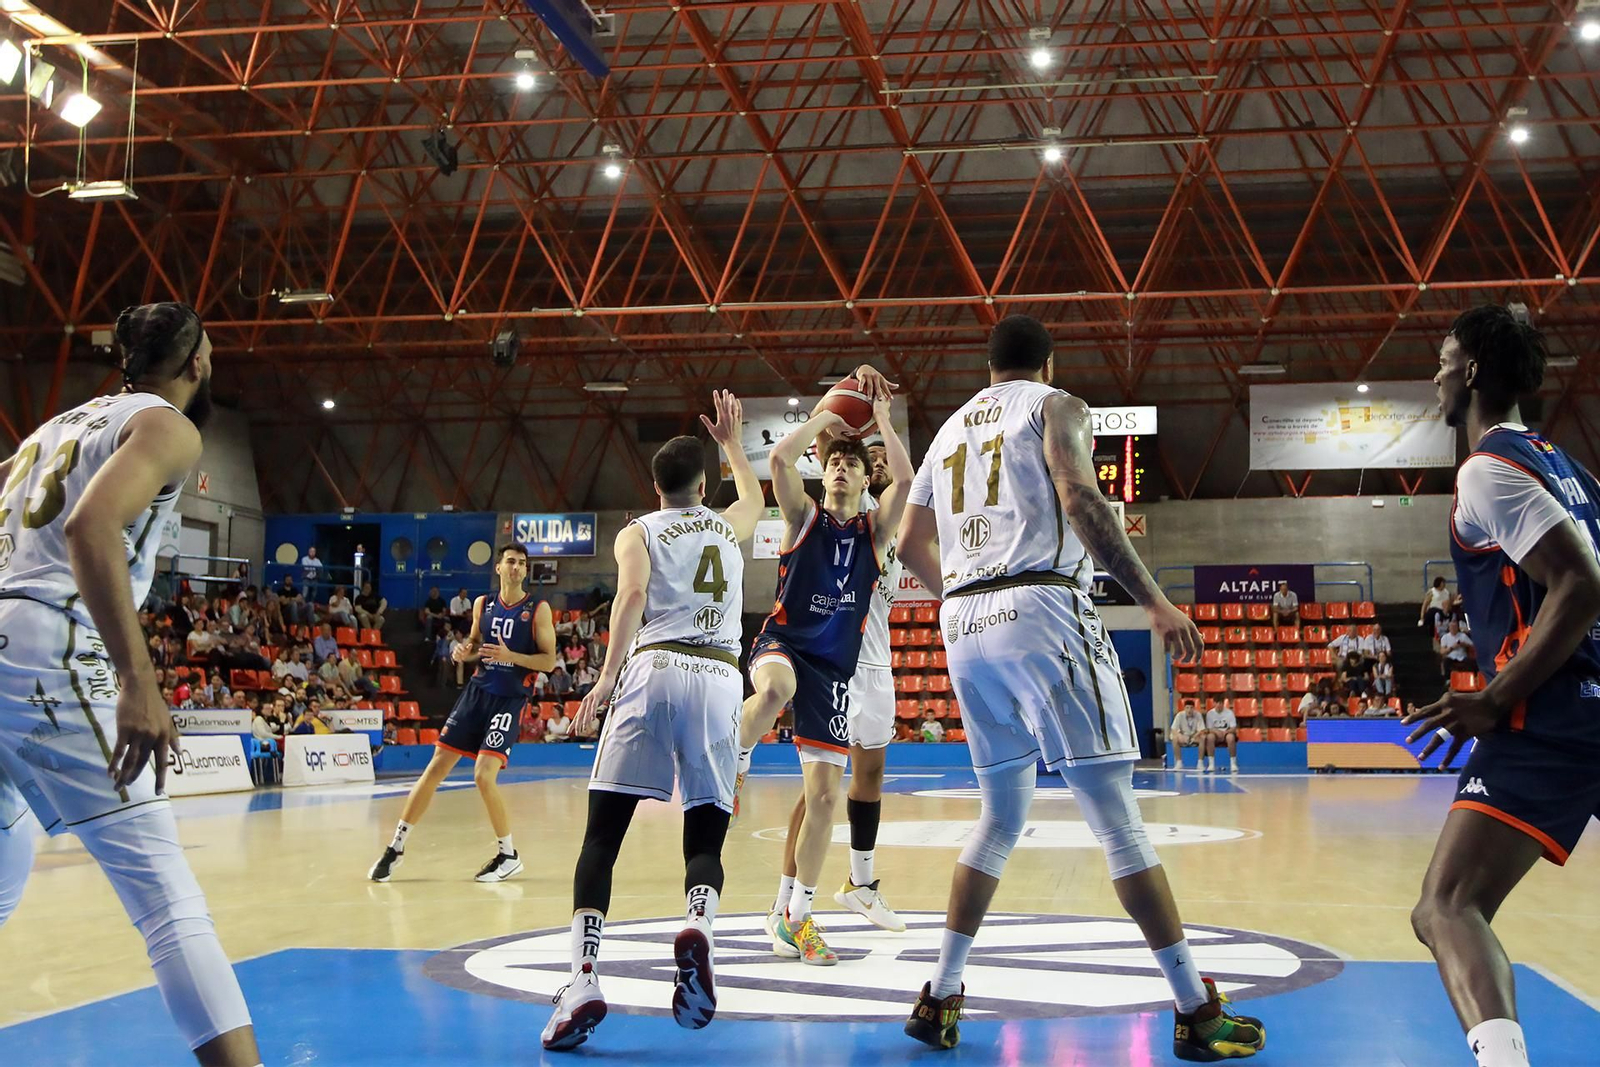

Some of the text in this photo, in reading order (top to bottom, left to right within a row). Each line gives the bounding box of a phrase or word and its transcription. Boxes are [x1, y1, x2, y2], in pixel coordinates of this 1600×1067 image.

[783, 408, 810, 424] ab
[963, 405, 1003, 428] KOLO
[1091, 412, 1137, 432] GOS
[942, 430, 1005, 515] 17
[1098, 464, 1118, 481] 23
[0, 440, 80, 529] 23
[516, 519, 574, 543] SALIDA
[833, 537, 855, 567] 17
[692, 544, 729, 603] 4
[490, 617, 515, 639] 50
[962, 608, 1019, 637] Logroño
[489, 712, 513, 732] 50
[1175, 1023, 1189, 1040] 23
